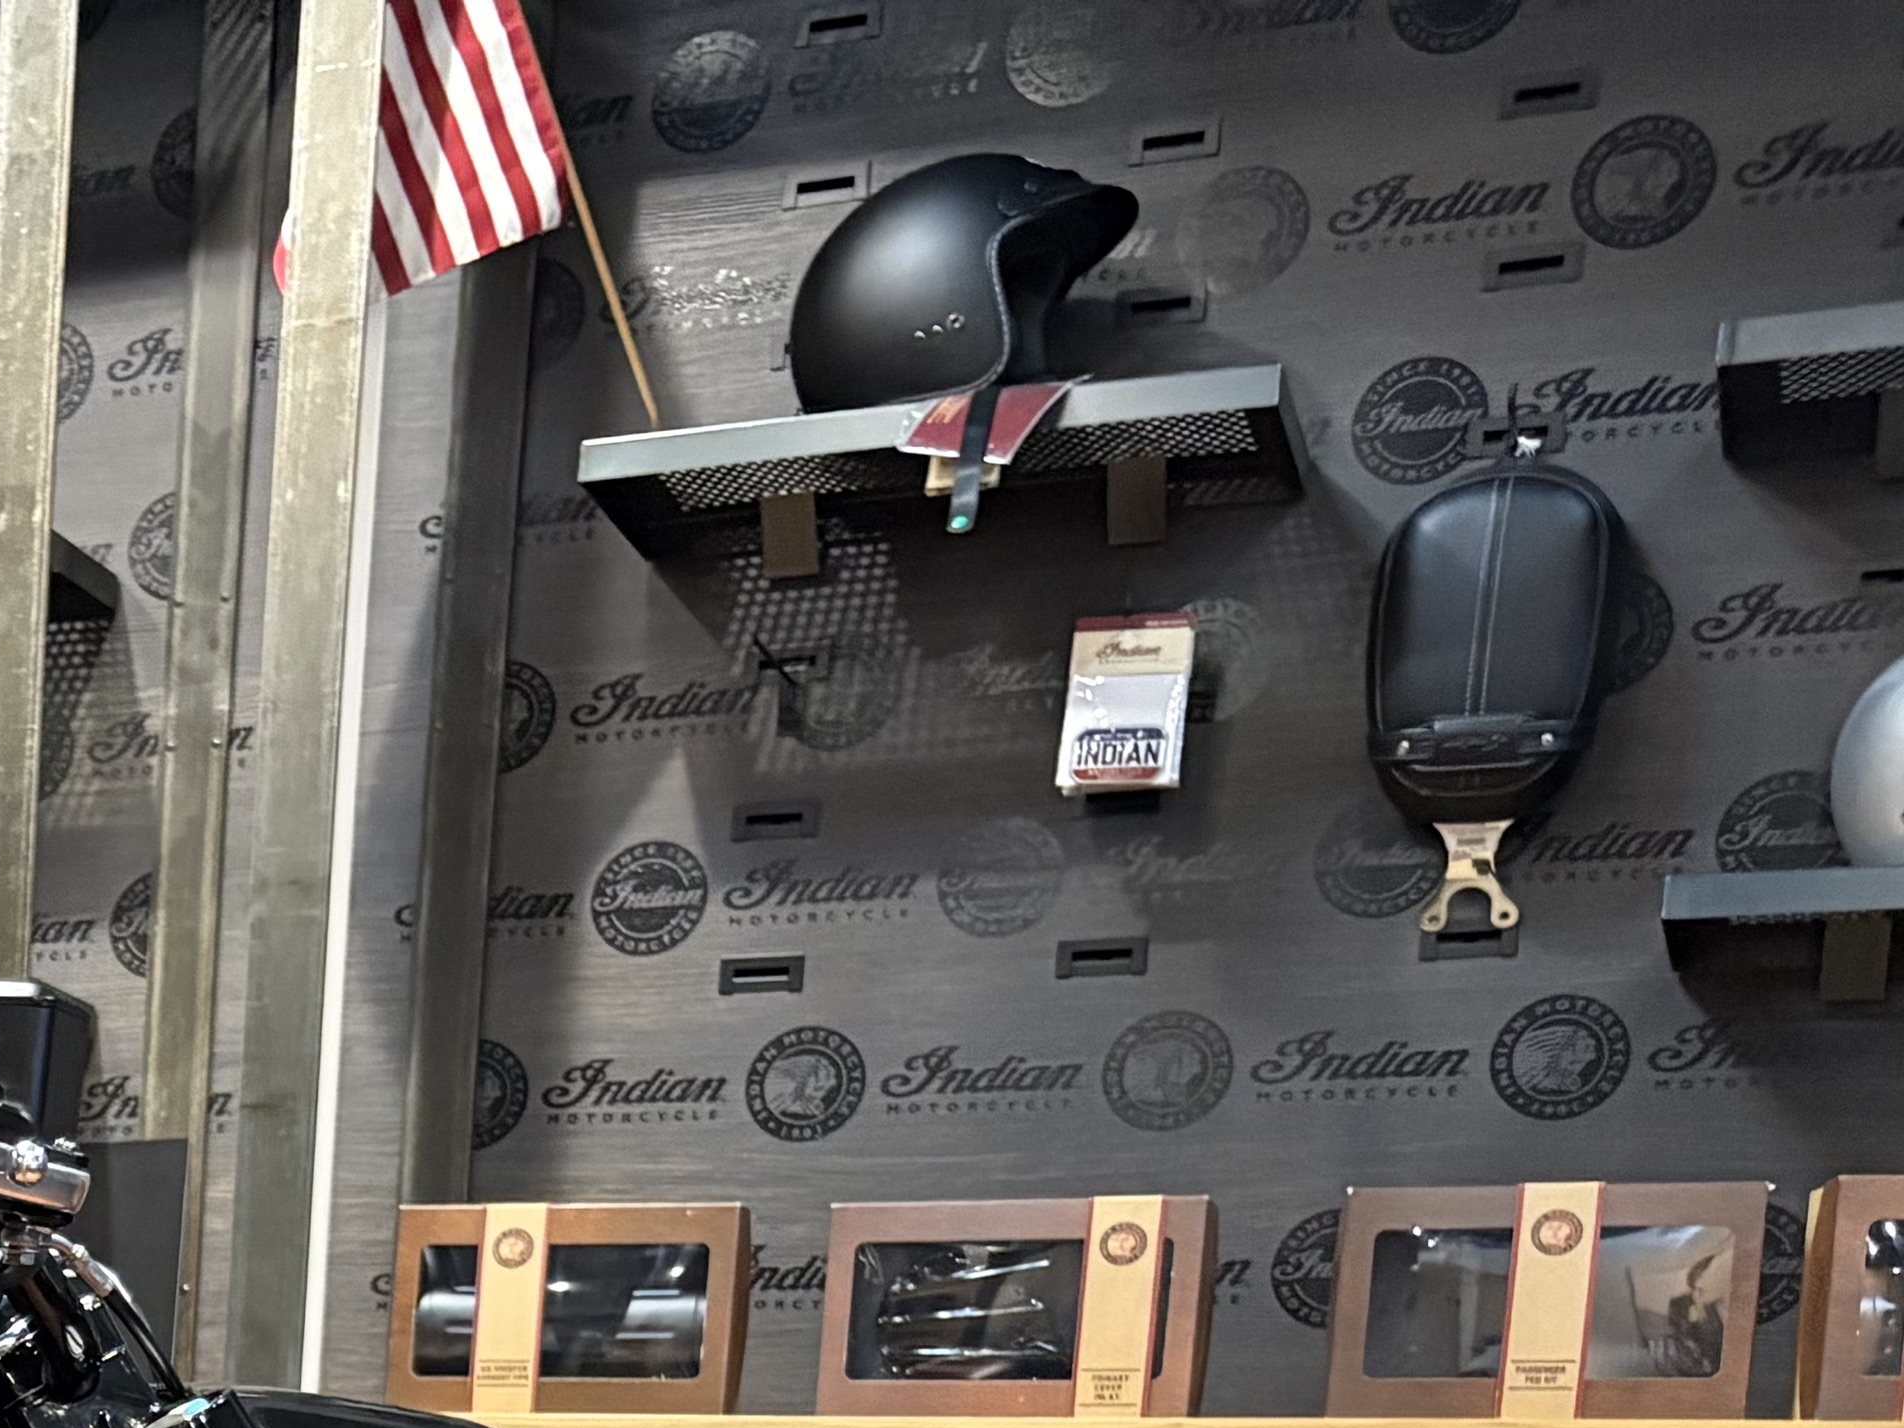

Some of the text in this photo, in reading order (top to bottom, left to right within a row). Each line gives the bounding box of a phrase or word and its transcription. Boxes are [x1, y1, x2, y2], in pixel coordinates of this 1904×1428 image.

[1328, 174, 1552, 238] Indian
[569, 672, 760, 729] Indian
[722, 860, 921, 912] Indian
[542, 1057, 728, 1109] Indian
[880, 1045, 1084, 1101] Indian
[1250, 1030, 1471, 1084] Indian
